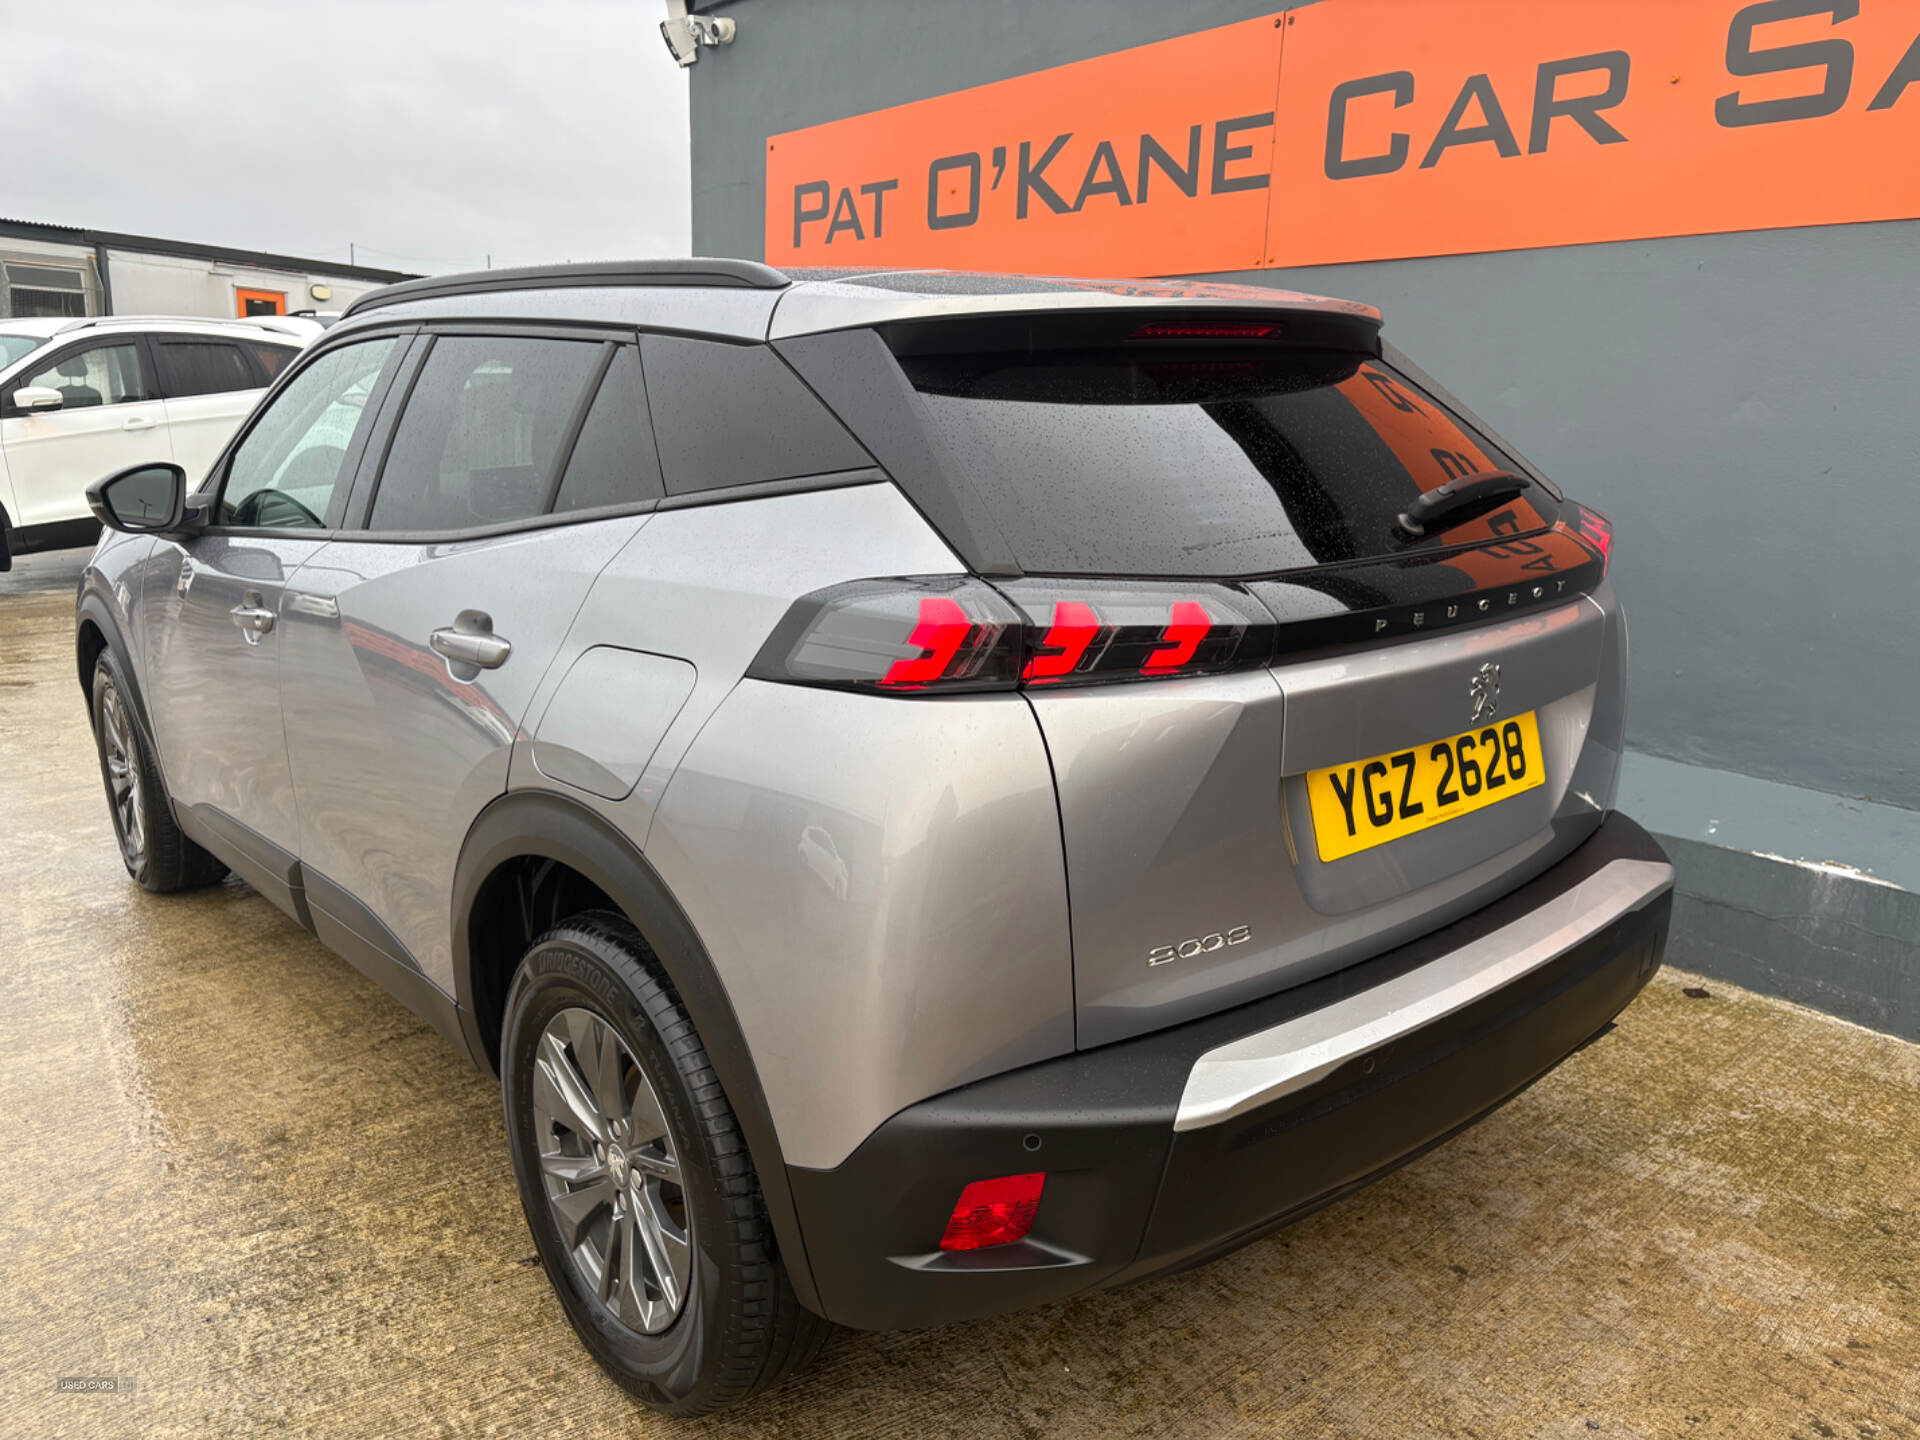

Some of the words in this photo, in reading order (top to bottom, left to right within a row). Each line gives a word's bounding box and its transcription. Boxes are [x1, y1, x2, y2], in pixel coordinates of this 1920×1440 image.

[793, 178, 899, 248] PAT
[927, 111, 1275, 231] O'KANE
[1323, 50, 1631, 181] CAR
[1375, 580, 1566, 632] PEUGEOT
[1329, 752, 1424, 836] YGZ
[1430, 721, 1526, 808] 2628
[1147, 924, 1252, 967] 2008
[538, 951, 620, 1005] BRIDGESTONE
